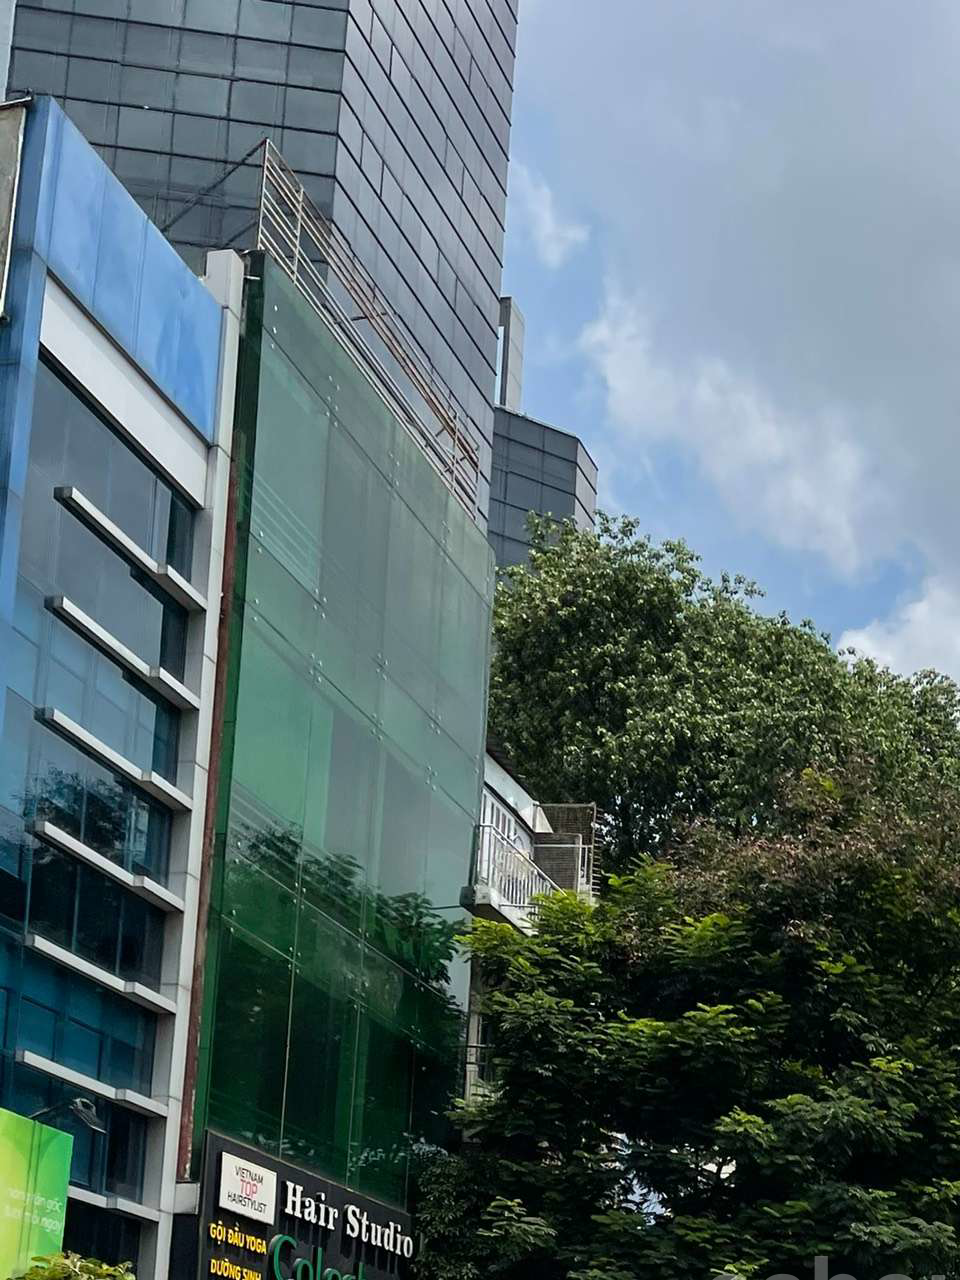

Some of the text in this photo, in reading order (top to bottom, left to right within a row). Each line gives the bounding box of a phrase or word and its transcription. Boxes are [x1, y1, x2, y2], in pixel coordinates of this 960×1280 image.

[234, 1165, 264, 1186] VIETNAM
[240, 1178, 258, 1198] TOP
[227, 1191, 267, 1213] HAIRSTYLIST
[284, 1180, 413, 1258] Hair Studio
[209, 1220, 226, 1245] GỘI
[245, 1234, 268, 1256] YOGA
